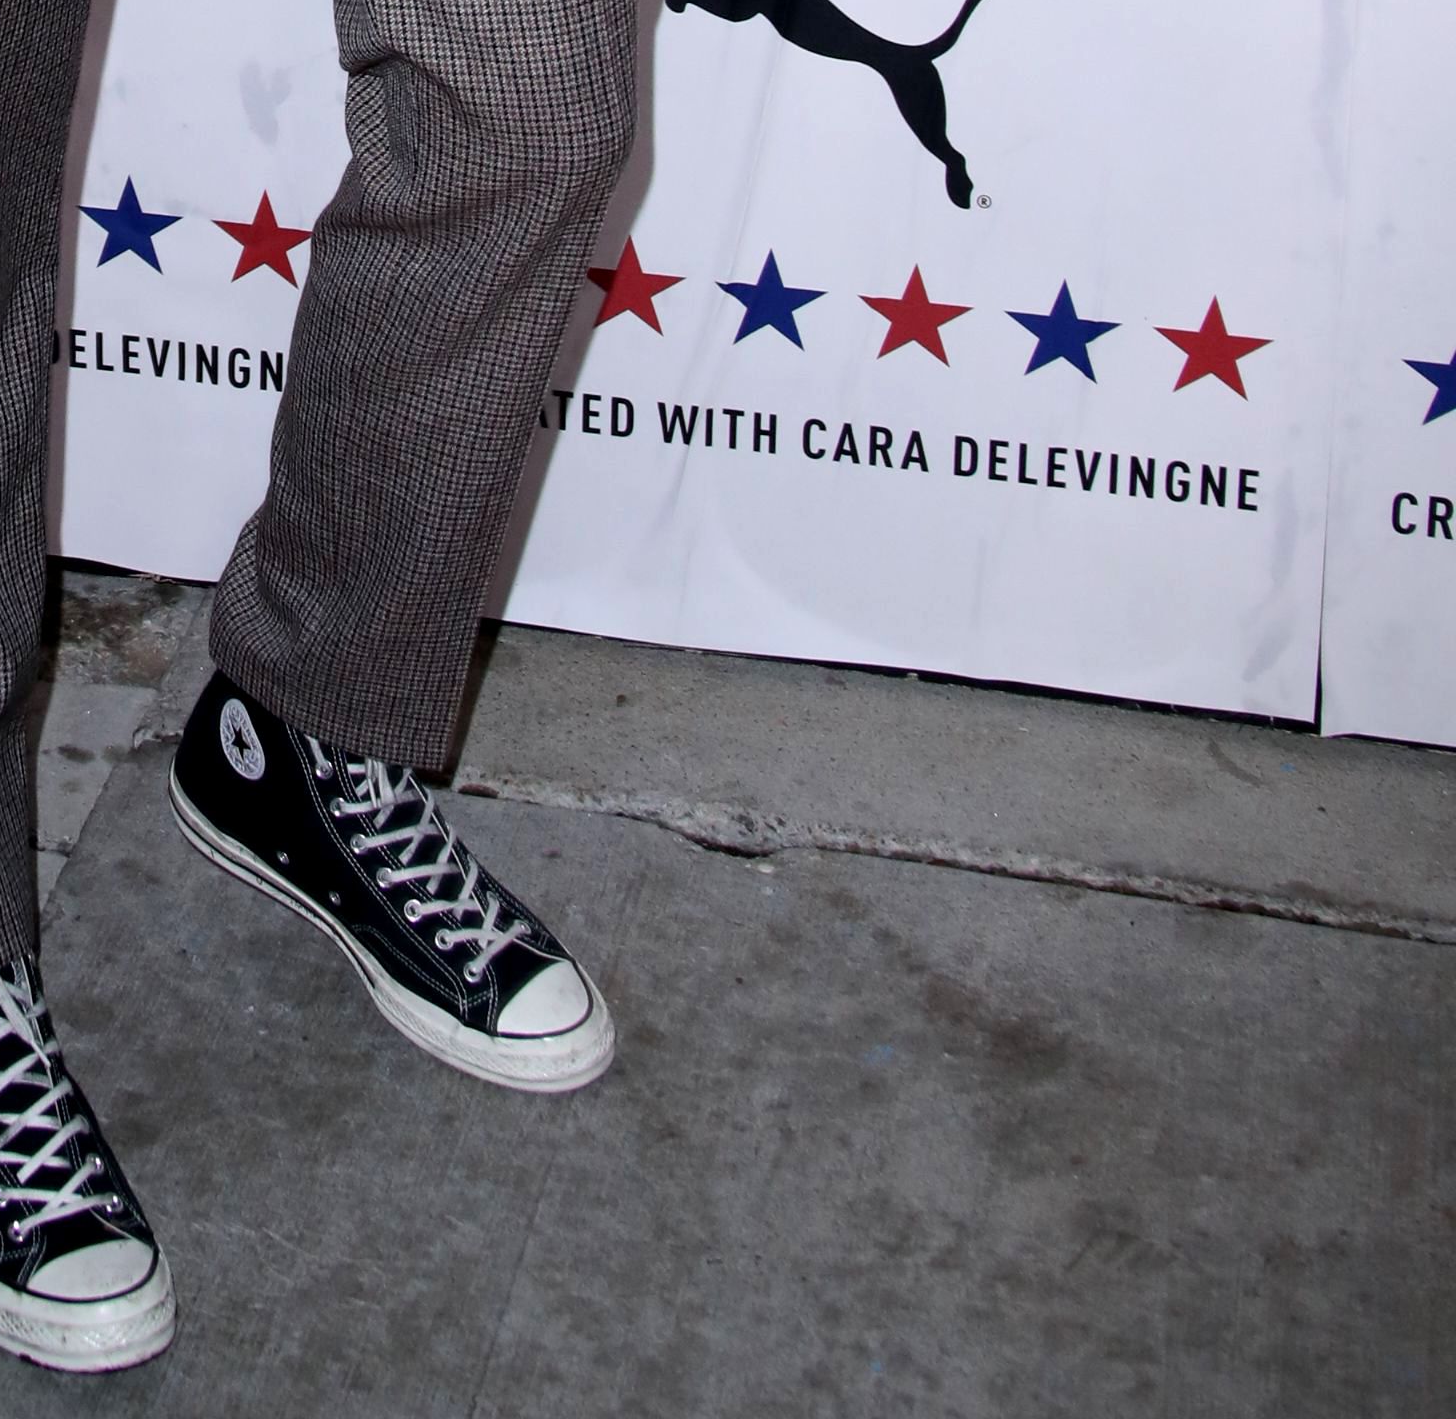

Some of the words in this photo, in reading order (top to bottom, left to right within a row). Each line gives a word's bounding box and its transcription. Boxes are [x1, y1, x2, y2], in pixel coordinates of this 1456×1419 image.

[539, 389, 635, 438] TED
[657, 401, 777, 454] WITH
[802, 418, 929, 473] CARA
[953, 435, 1260, 512] DELEVINGNE
[1391, 491, 1455, 541] CR
